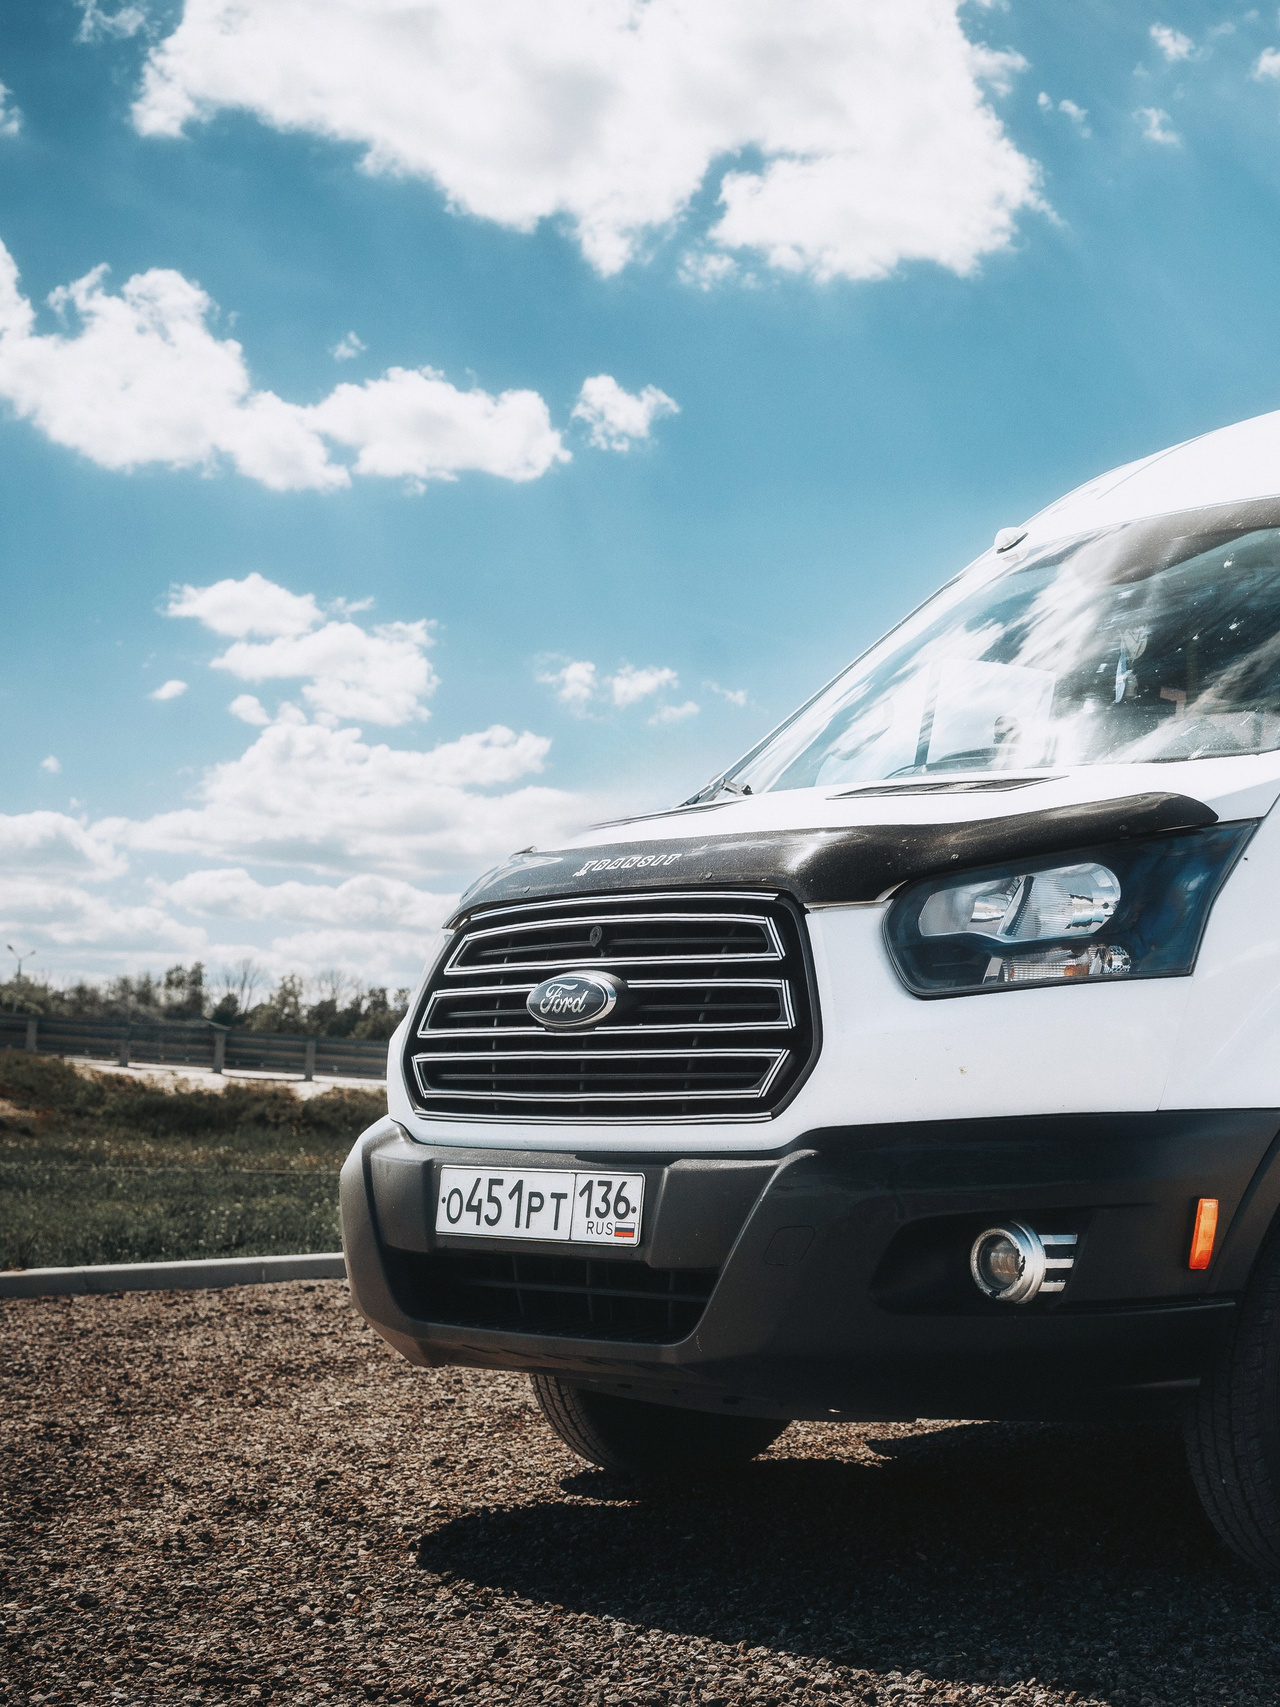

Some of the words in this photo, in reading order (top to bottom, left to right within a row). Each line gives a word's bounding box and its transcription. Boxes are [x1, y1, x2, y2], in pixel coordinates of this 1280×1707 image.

[572, 853, 682, 877] TRANSIT
[540, 983, 589, 1014] Ford
[579, 1179, 630, 1220] 136
[586, 1221, 613, 1235] RUS
